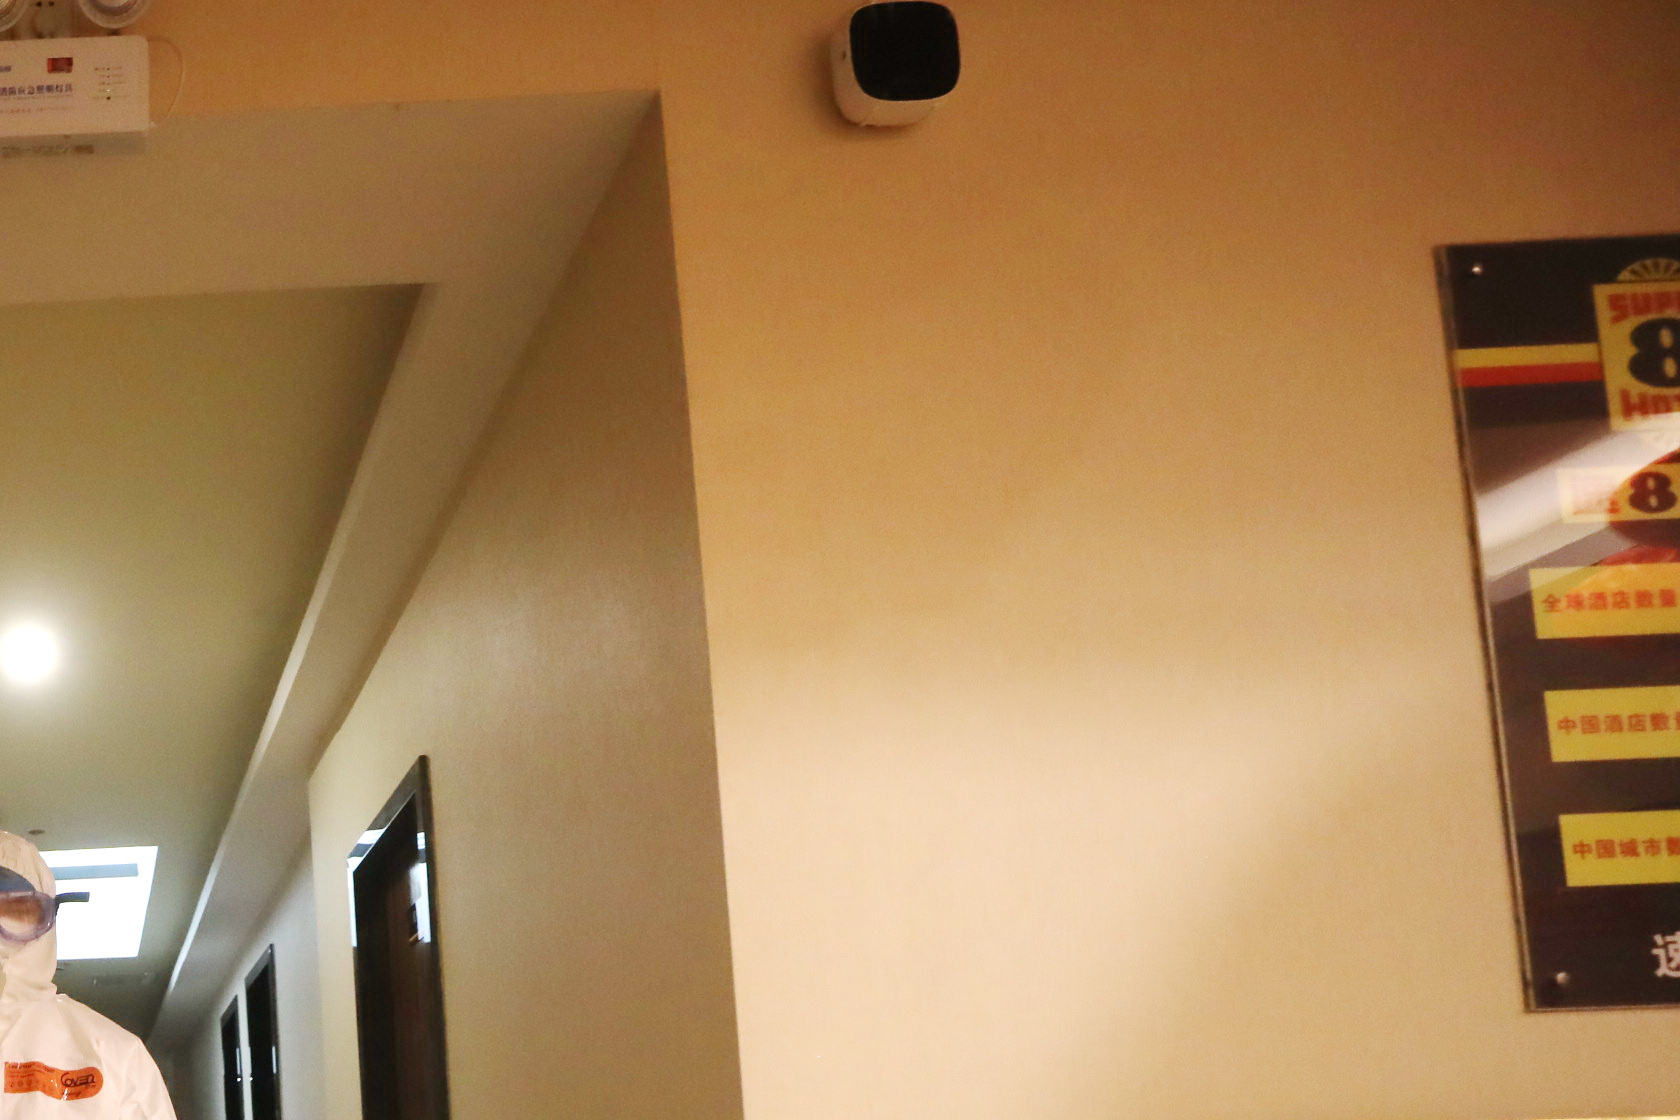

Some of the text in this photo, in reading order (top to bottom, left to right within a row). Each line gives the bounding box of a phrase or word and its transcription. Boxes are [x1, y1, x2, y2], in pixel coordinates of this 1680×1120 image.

[1629, 318, 1680, 388] 8
[1629, 471, 1678, 515] 8
[1557, 711, 1680, 736] 中国酒店数
